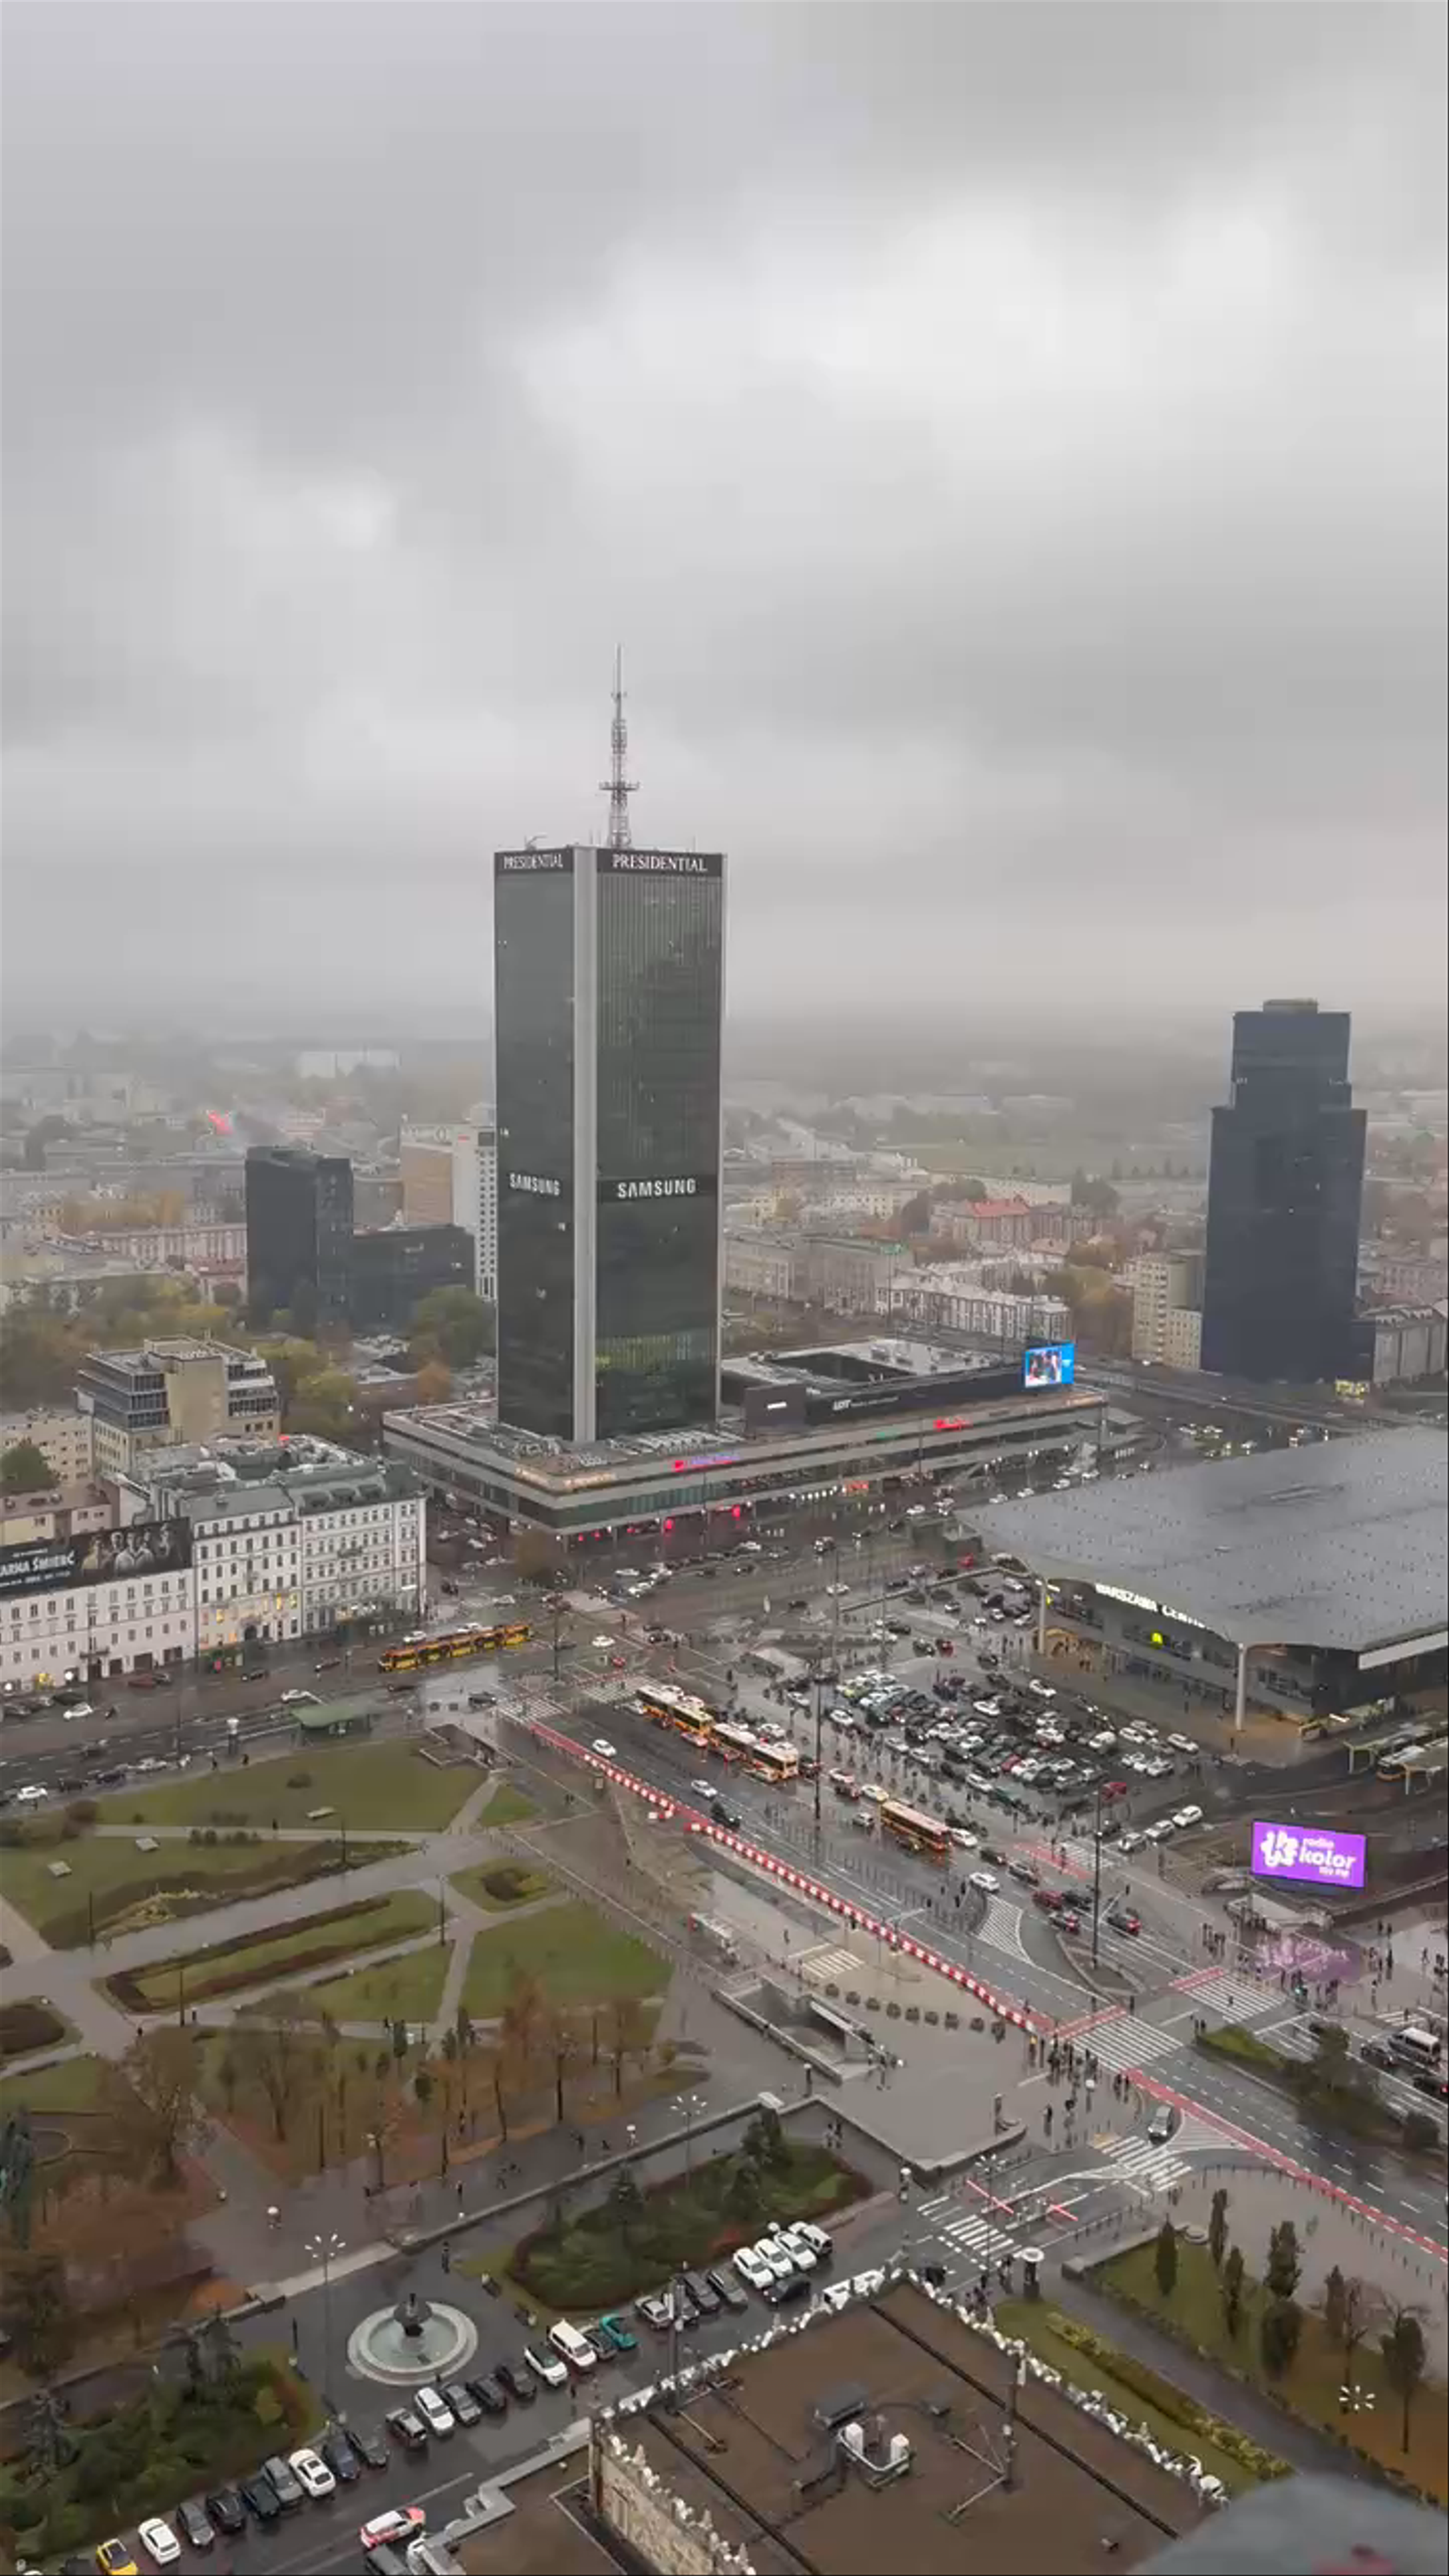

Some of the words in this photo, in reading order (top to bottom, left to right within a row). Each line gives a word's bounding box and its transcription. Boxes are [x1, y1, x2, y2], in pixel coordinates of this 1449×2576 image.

[504, 854, 563, 869] PRESIDENTIAL
[613, 854, 707, 872] PRESIDENTIAL
[509, 1173, 560, 1195] SAMSUNG
[618, 1178, 696, 1198] SAMSUNG
[1299, 1847, 1356, 1868] kolor
